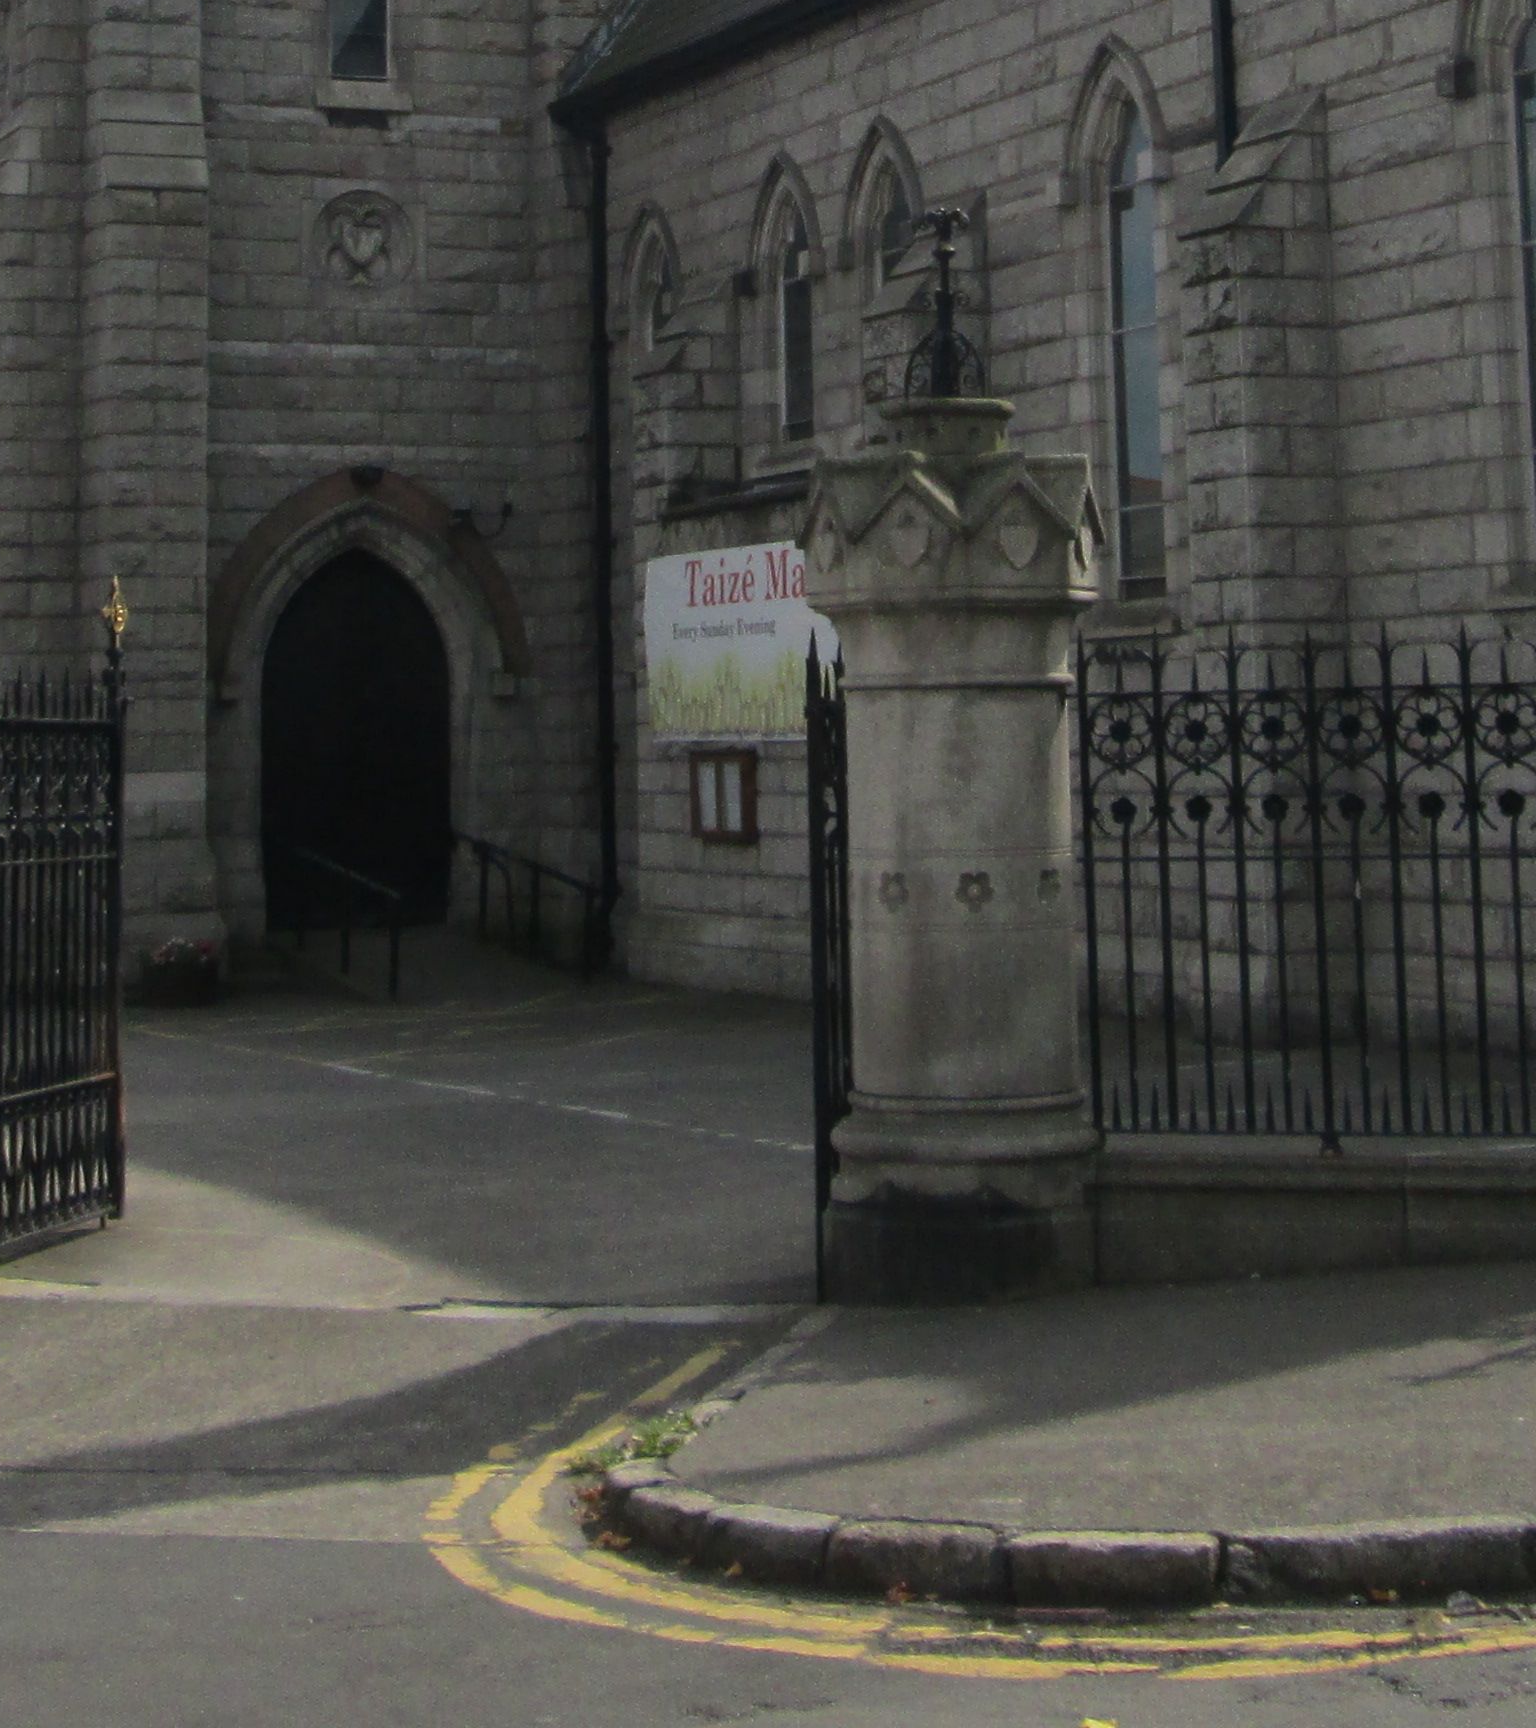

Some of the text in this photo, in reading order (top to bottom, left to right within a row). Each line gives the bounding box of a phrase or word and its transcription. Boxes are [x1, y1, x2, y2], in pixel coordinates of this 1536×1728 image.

[684, 553, 755, 607] Taizé
[672, 617, 776, 642] Every Sunday Evening
